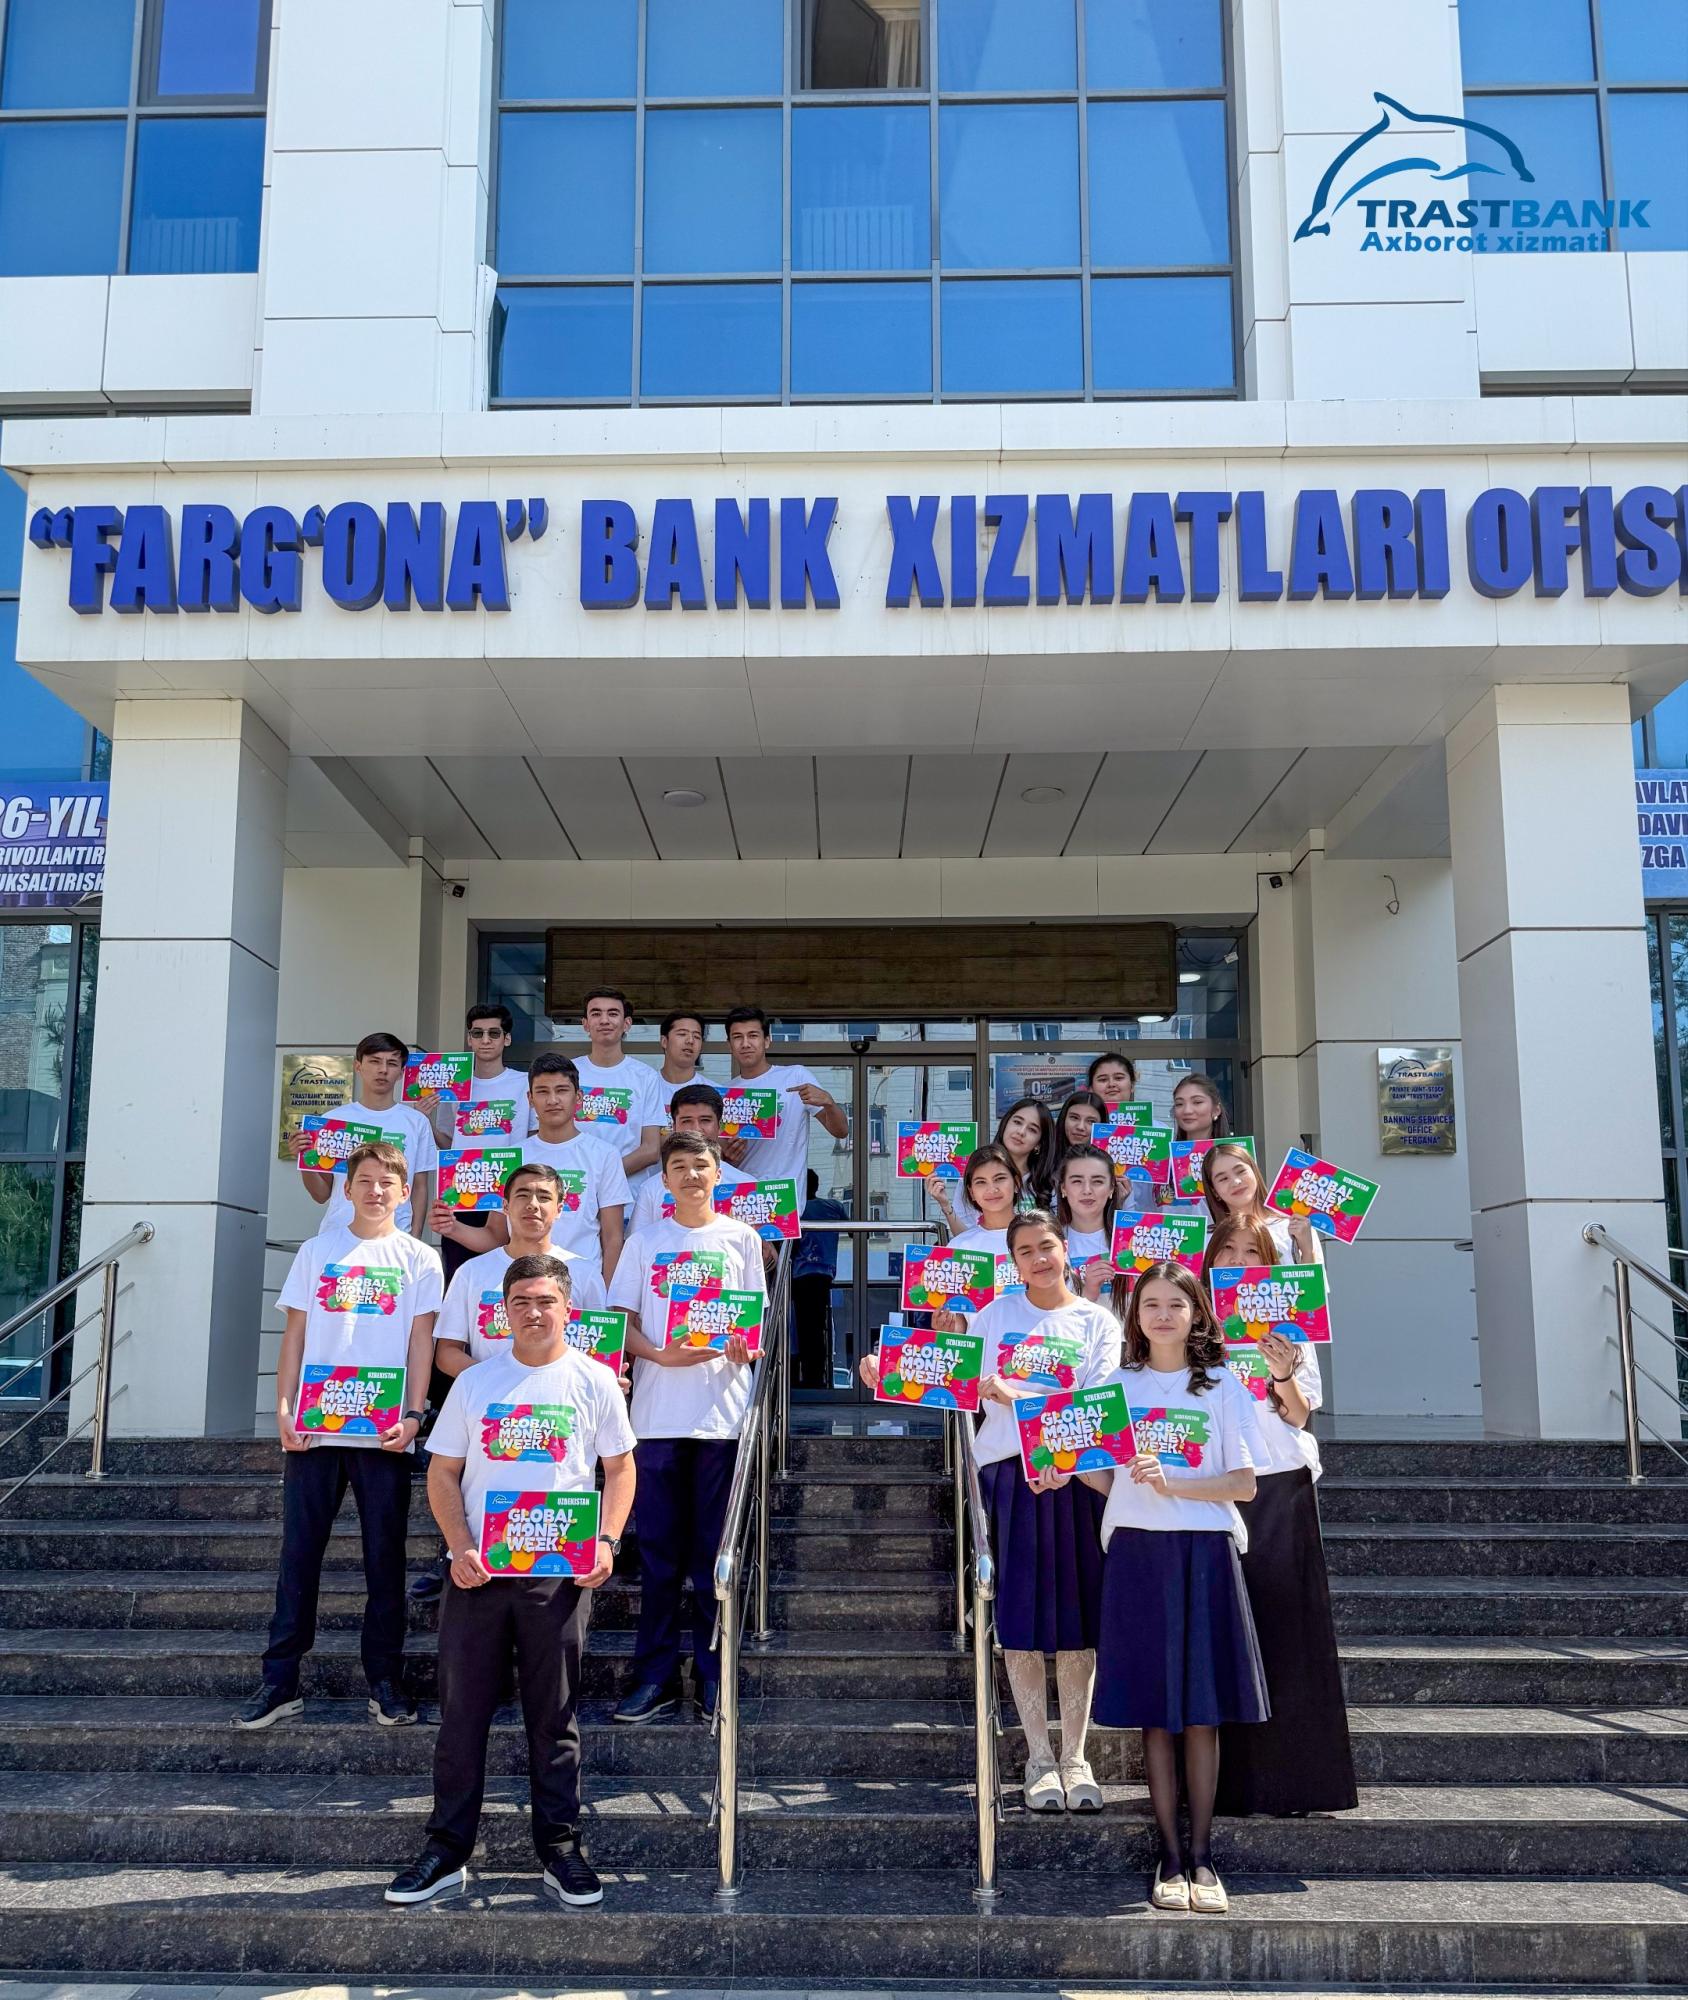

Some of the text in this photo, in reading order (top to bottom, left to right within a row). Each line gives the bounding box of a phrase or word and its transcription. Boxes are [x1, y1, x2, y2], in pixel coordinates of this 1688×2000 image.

[580, 497, 840, 610] BANK
[886, 489, 1451, 609] XIZMATLARI
[418, 1063, 461, 1072] GLOBAL
[418, 1071, 456, 1081] MONEY
[722, 1097, 764, 1108] GLOBAL
[722, 1106, 760, 1116] MONEY
[1384, 1115, 1454, 1124] BANKING SERVICES
[319, 1129, 367, 1144] GLOBAL
[1407, 1126, 1432, 1134] OFFICE
[914, 1133, 962, 1144] GLOBAL
[1108, 1136, 1156, 1149] GLOBAL
[914, 1143, 957, 1153] MONEY
[1108, 1145, 1151, 1157] MONEY
[455, 1160, 507, 1172] GLOBAL
[455, 1171, 502, 1183] MONEY
[1296, 1178, 1347, 1205] MONEY
[1301, 1169, 1354, 1200] GLOBAL
[731, 1193, 782, 1206] GLOBAL
[731, 1202, 777, 1216] MONEY
[1133, 1225, 1189, 1240] GLOBAL
[1132, 1236, 1183, 1250] MONEY
[924, 1259, 979, 1275] GLOBAL
[336, 1275, 389, 1289] GLOBAL
[924, 1270, 973, 1284] MONEY
[335, 1285, 384, 1297] MONEY
[1236, 1281, 1305, 1297] GLOBAL
[688, 1300, 746, 1315] GLOBAL
[1238, 1294, 1299, 1309] MONEY
[688, 1310, 739, 1324] MONEY
[901, 1343, 963, 1364] GLOBAL
[1013, 1343, 1067, 1359] GLOBAL
[900, 1356, 958, 1374] MONEY
[1012, 1352, 1061, 1366] MONEY
[323, 1379, 385, 1394] GLOBAL
[320, 1392, 379, 1405] MONEY
[1040, 1403, 1108, 1426] GLOBAL
[500, 1417, 559, 1431] GLOBAL
[1043, 1417, 1102, 1440] MONEY
[1135, 1420, 1195, 1435] GLOBAL
[499, 1428, 553, 1440] MONEY
[1135, 1430, 1188, 1443] MONEY
[557, 1497, 590, 1506] UZBEKISTAN
[508, 1508, 578, 1524] GLOBAL
[507, 1521, 571, 1538] MONEY
